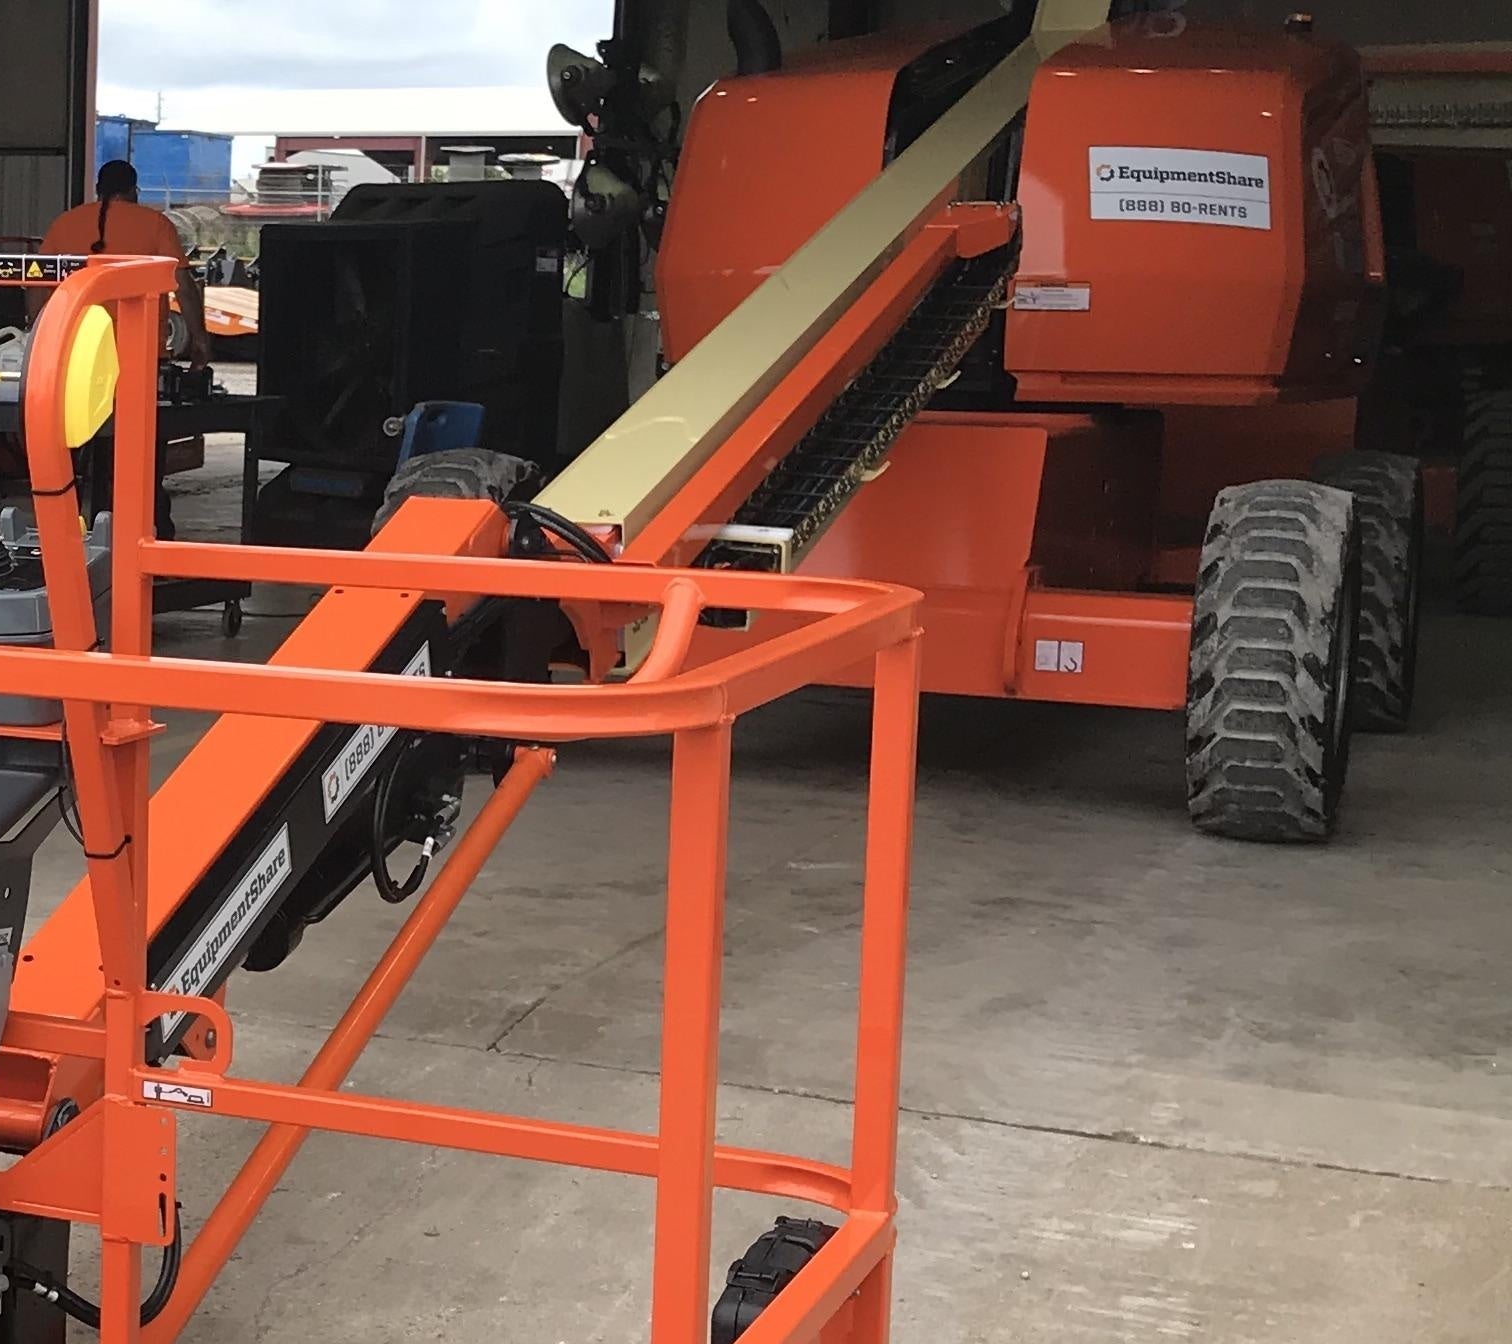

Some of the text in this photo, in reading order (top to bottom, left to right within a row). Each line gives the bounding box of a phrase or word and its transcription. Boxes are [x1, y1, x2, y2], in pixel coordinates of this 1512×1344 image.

[1118, 166, 1264, 189] EquipmentShare
[1119, 198, 1248, 219] (888) 80-RENTS
[344, 726, 375, 780] (888)
[180, 847, 286, 996] EquipmentShare
